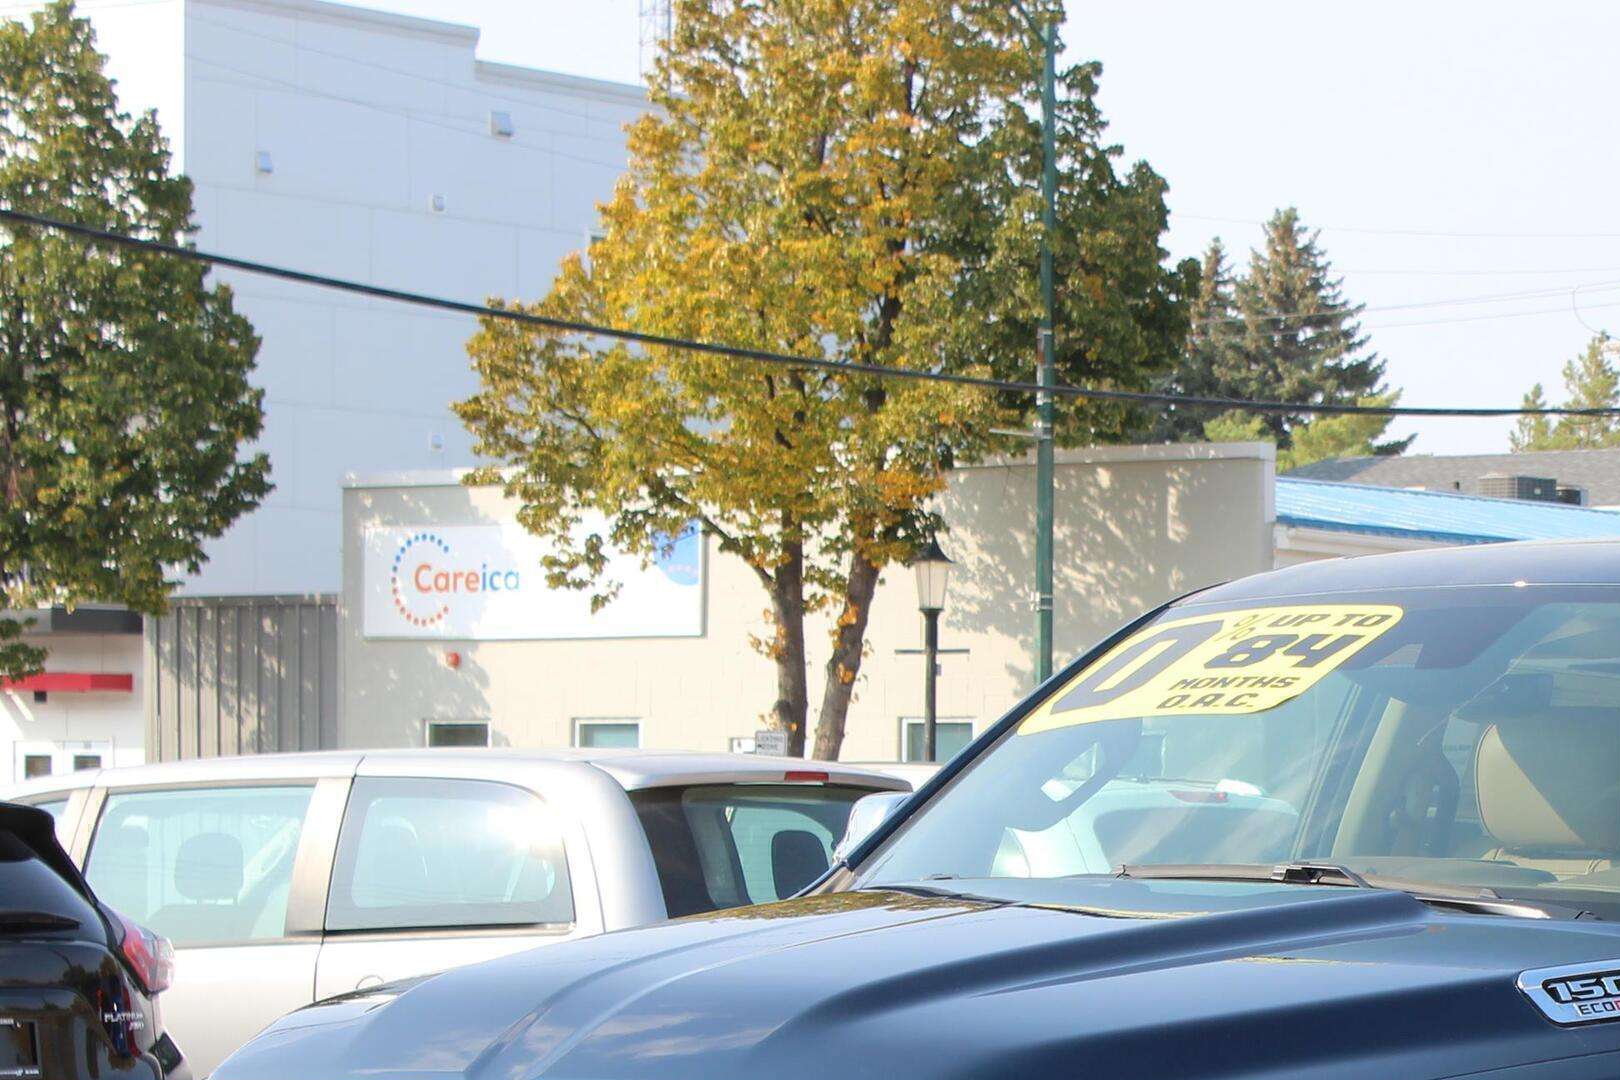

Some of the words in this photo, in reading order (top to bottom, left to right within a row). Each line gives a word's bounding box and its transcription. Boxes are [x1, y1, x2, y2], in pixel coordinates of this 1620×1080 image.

[413, 563, 520, 593] Careica
[1267, 613, 1331, 628] UP
[1332, 613, 1393, 628] TO
[1203, 633, 1366, 669] 84
[1168, 676, 1302, 691] MONTHS
